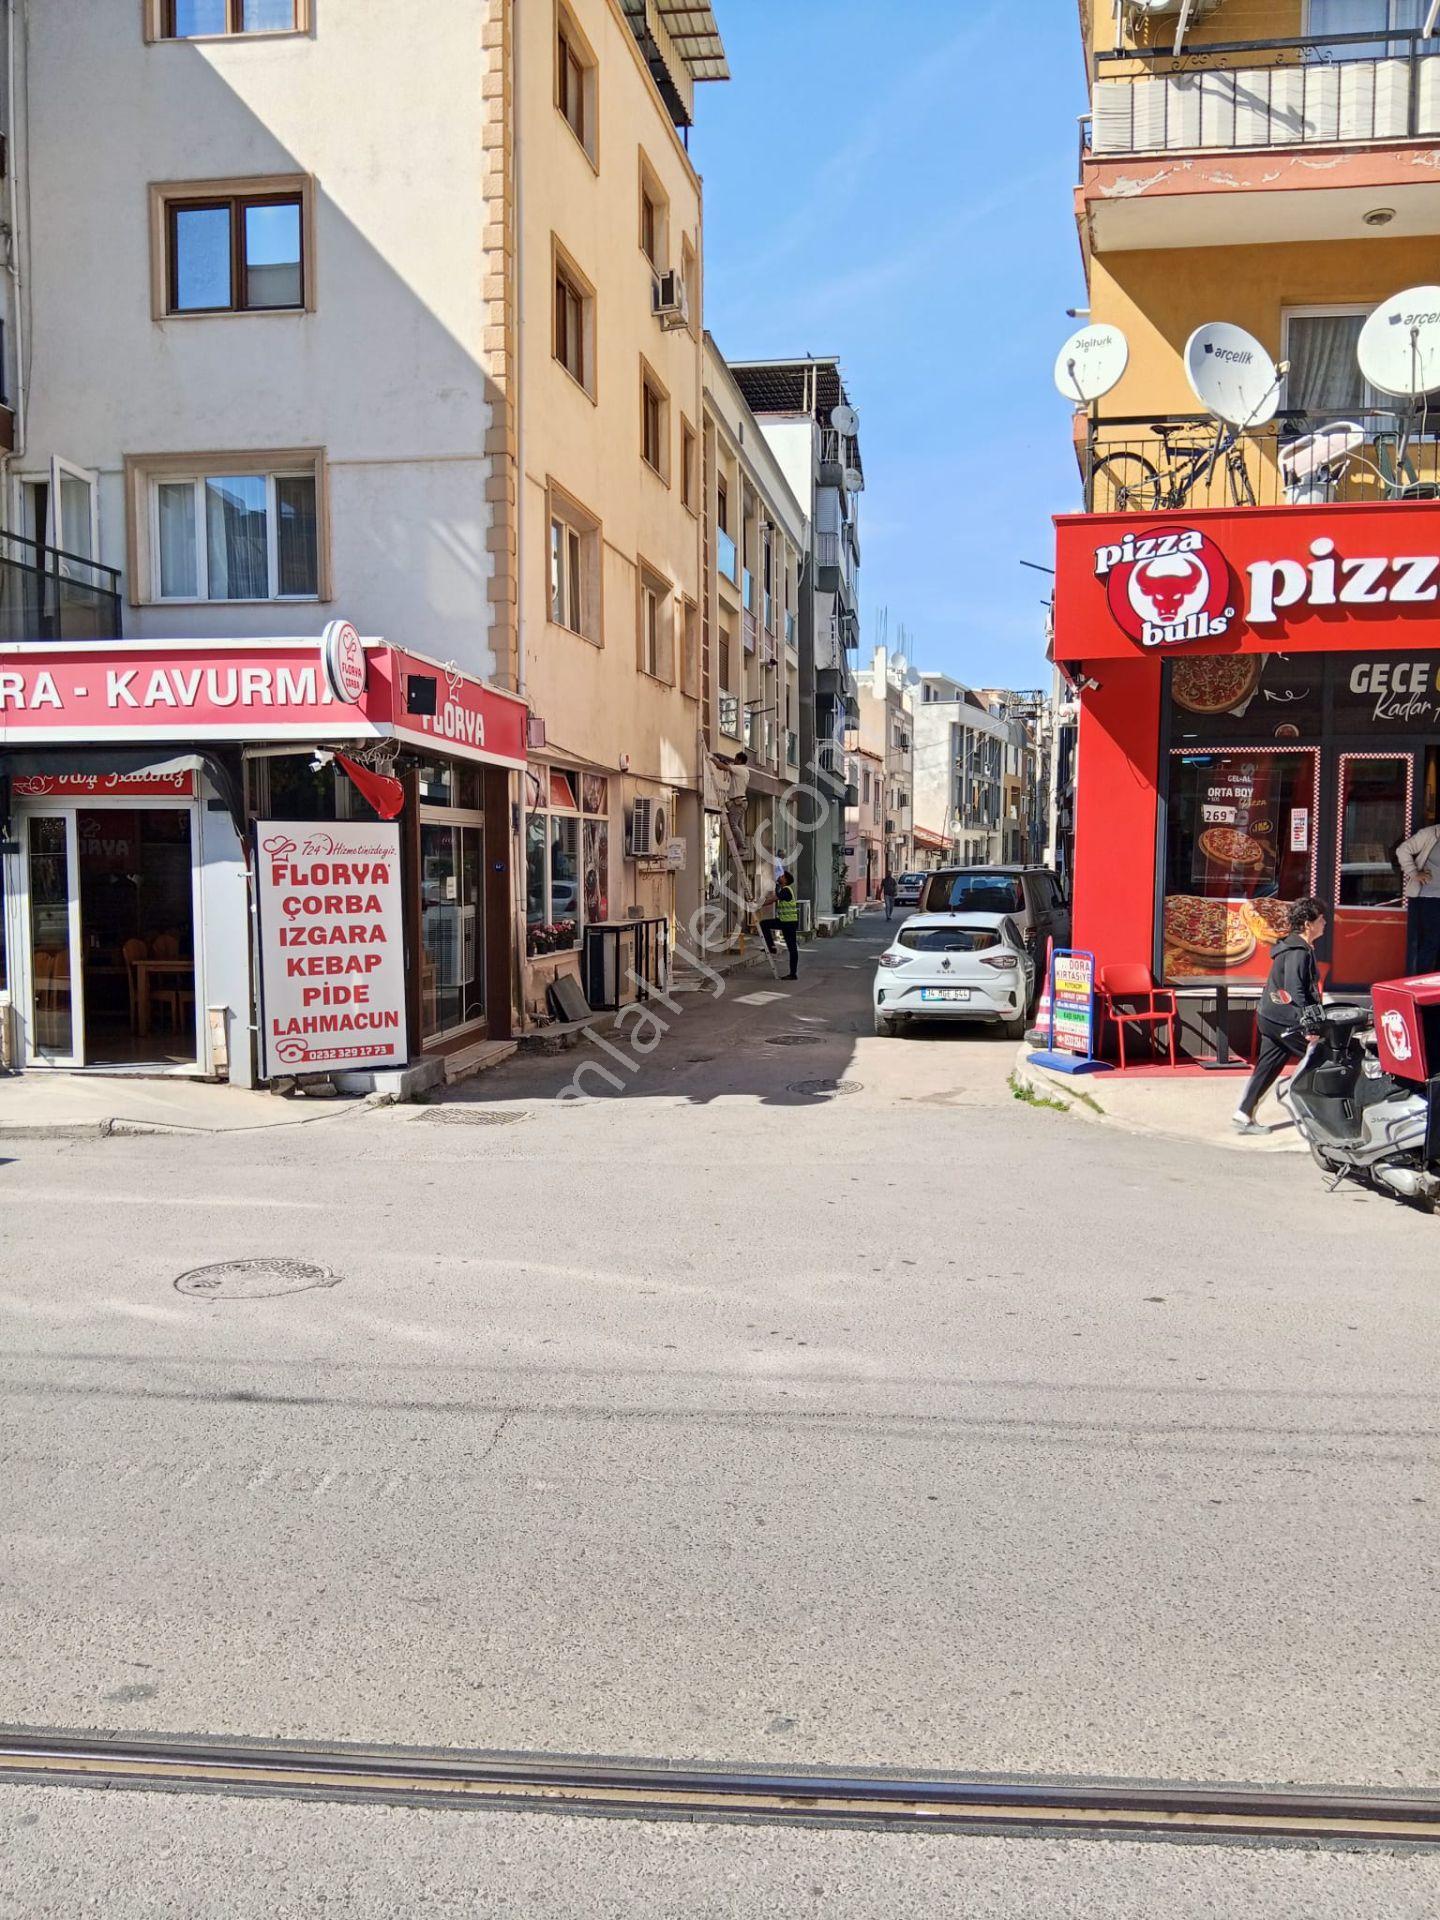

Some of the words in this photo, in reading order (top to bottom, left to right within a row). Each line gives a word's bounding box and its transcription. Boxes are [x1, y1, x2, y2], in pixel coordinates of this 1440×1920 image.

[1215, 346, 1254, 366] arçelik
[1095, 530, 1203, 575] pizza
[1245, 537, 1440, 623] pizz
[1142, 613, 1228, 647] bulls
[0, 671, 63, 709] RA
[1349, 663, 1431, 694] GECE
[1371, 690, 1432, 722] Kadar
[1207, 787, 1232, 797] ORTA
[1234, 788, 1254, 797] BOY
[1205, 810, 1227, 821] 269
[272, 863, 390, 887] FLORYA
[282, 895, 383, 921] ÇORBA
[279, 924, 387, 947] IZGARA
[287, 954, 382, 977] KEBAP
[303, 981, 370, 1006] PİDE
[273, 1010, 399, 1036] LAHMACUN
